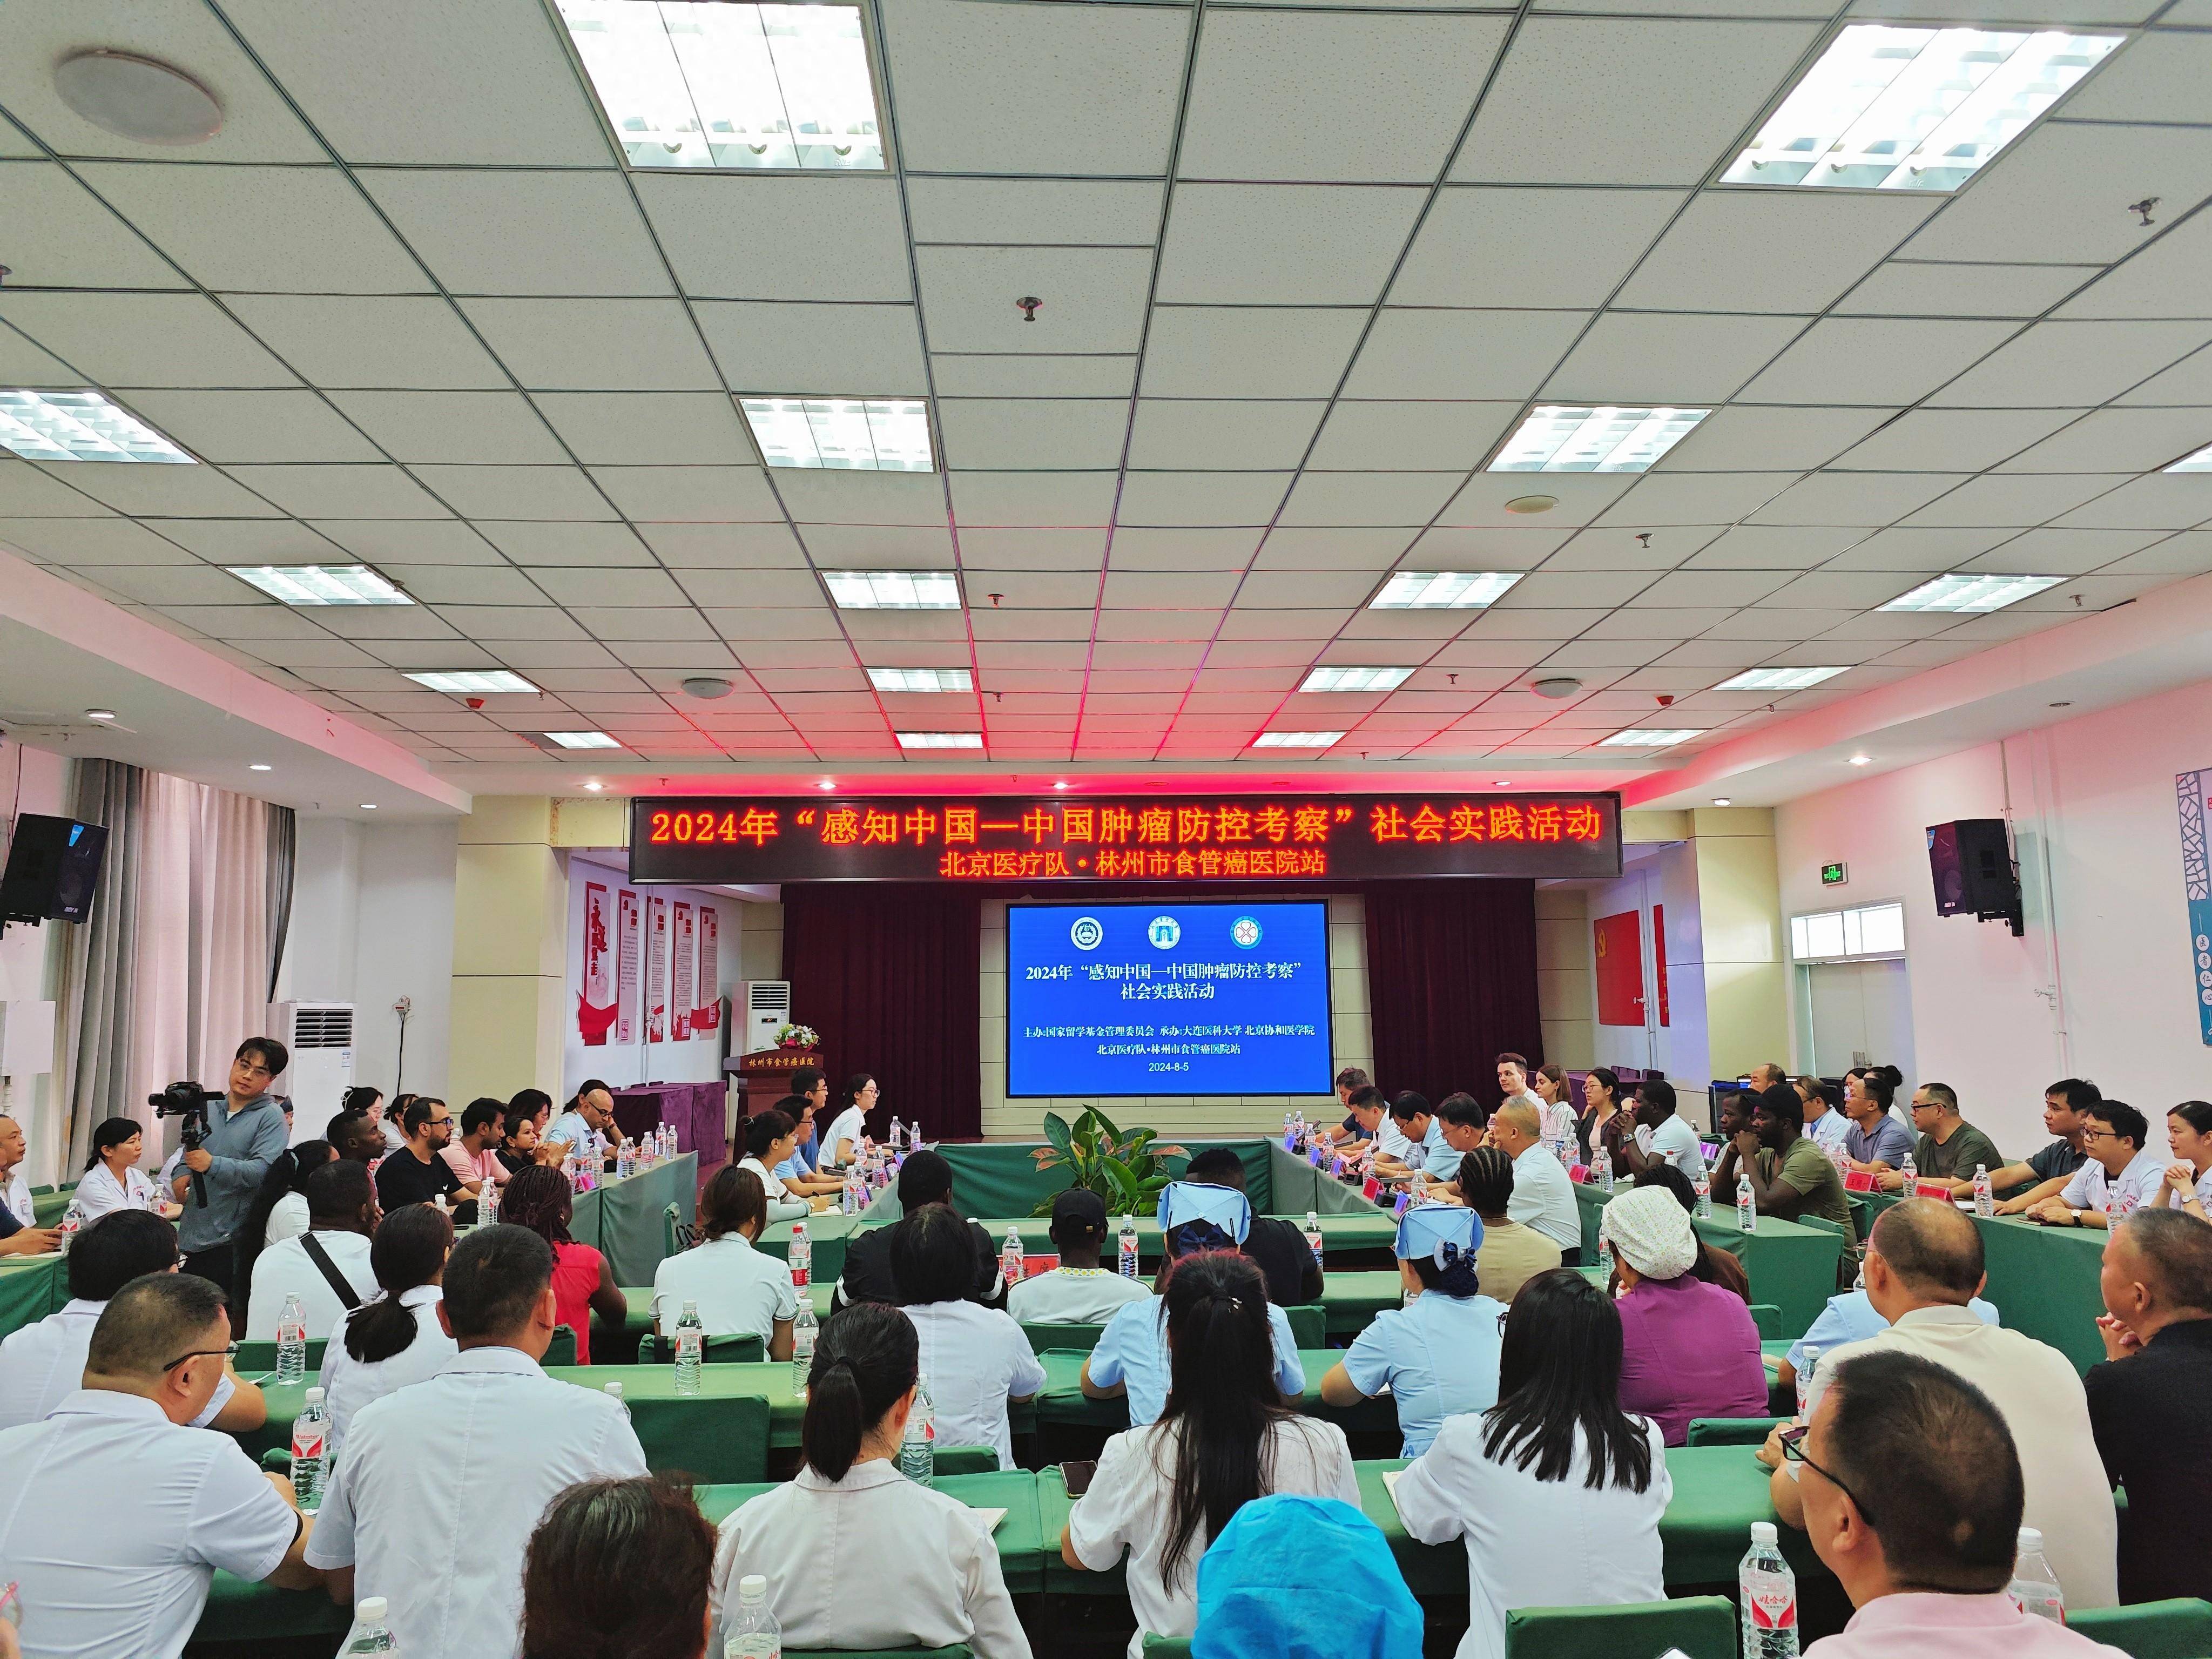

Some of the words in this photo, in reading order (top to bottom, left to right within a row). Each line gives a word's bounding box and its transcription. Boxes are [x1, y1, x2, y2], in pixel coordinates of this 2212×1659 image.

[1120, 983, 1215, 1000] 社会实践活动
[1244, 1024, 1316, 1036] 北京协和医学院
[748, 1057, 814, 1068] 林州市食管癌医院
[1149, 1062, 1189, 1072] 2024-8-5
[1758, 1594, 1788, 1604] 娃哈哈
